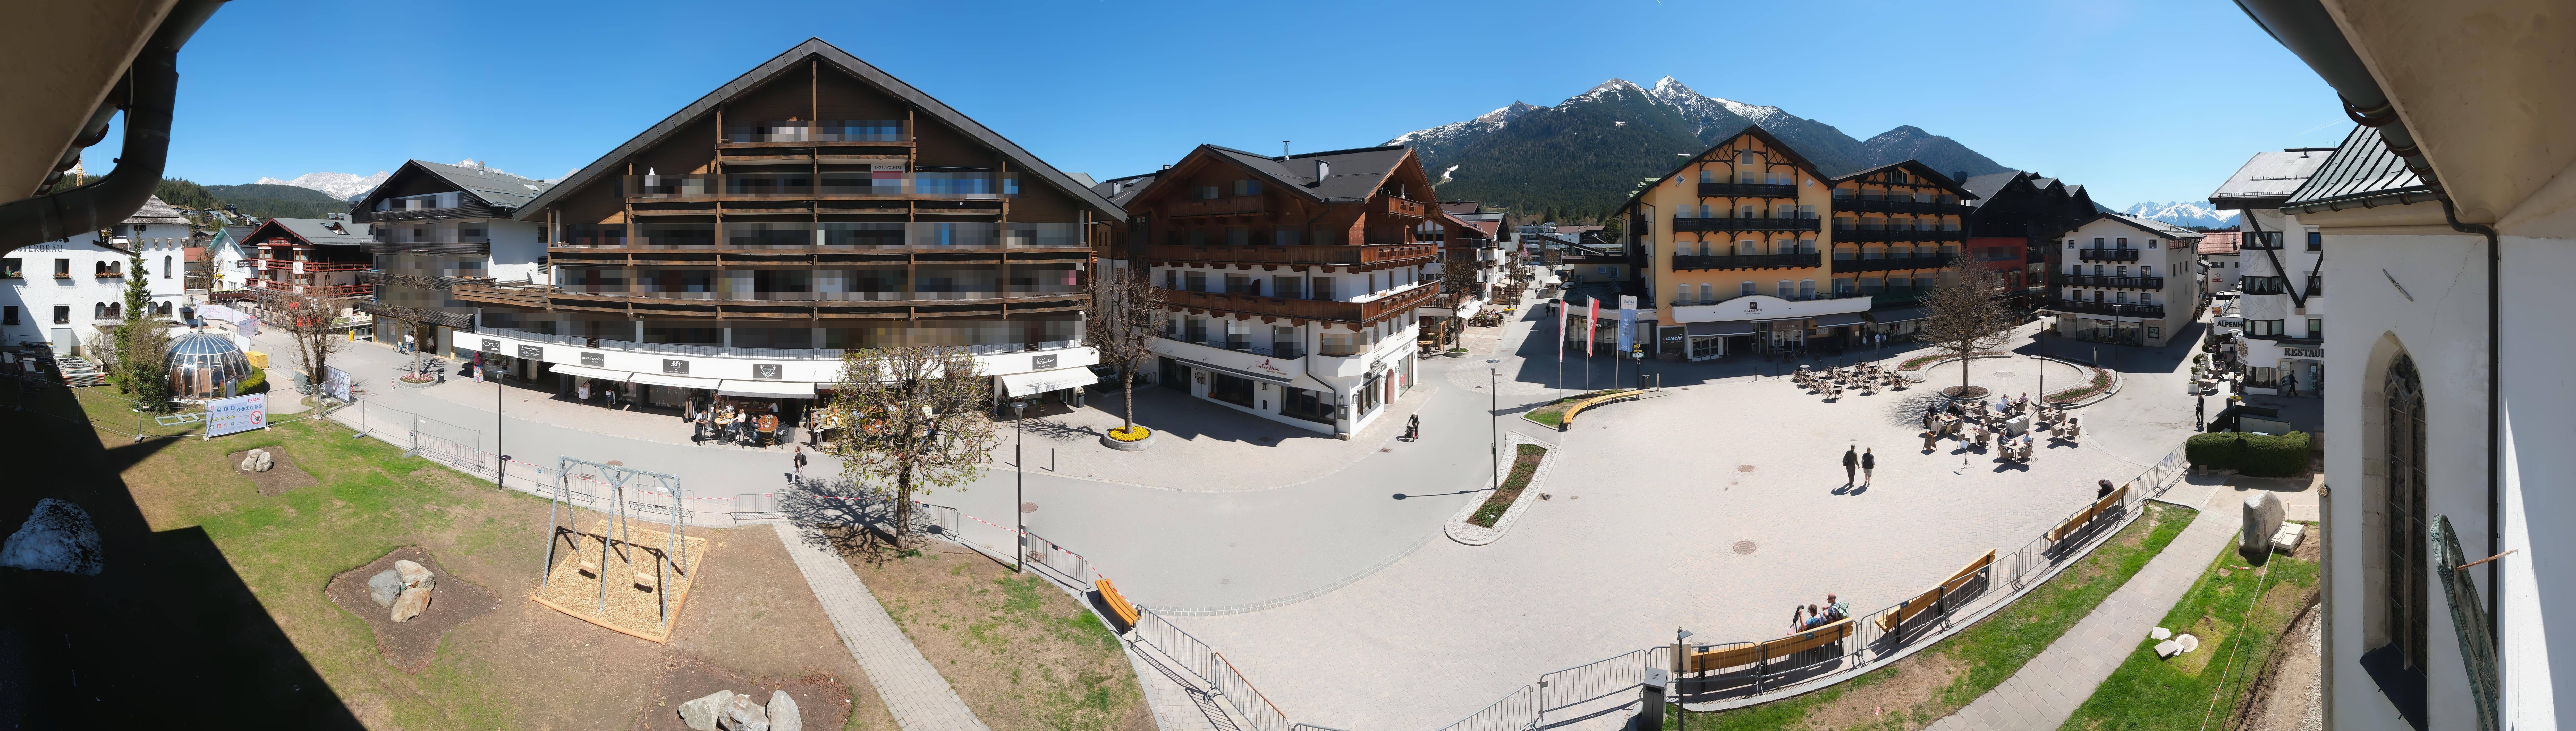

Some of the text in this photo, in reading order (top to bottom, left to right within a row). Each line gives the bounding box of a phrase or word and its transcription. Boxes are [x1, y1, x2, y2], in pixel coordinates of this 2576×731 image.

[12, 244, 63, 252] STERBRÄU
[671, 361, 682, 370] My
[1372, 364, 1386, 377] RESTAURANT
